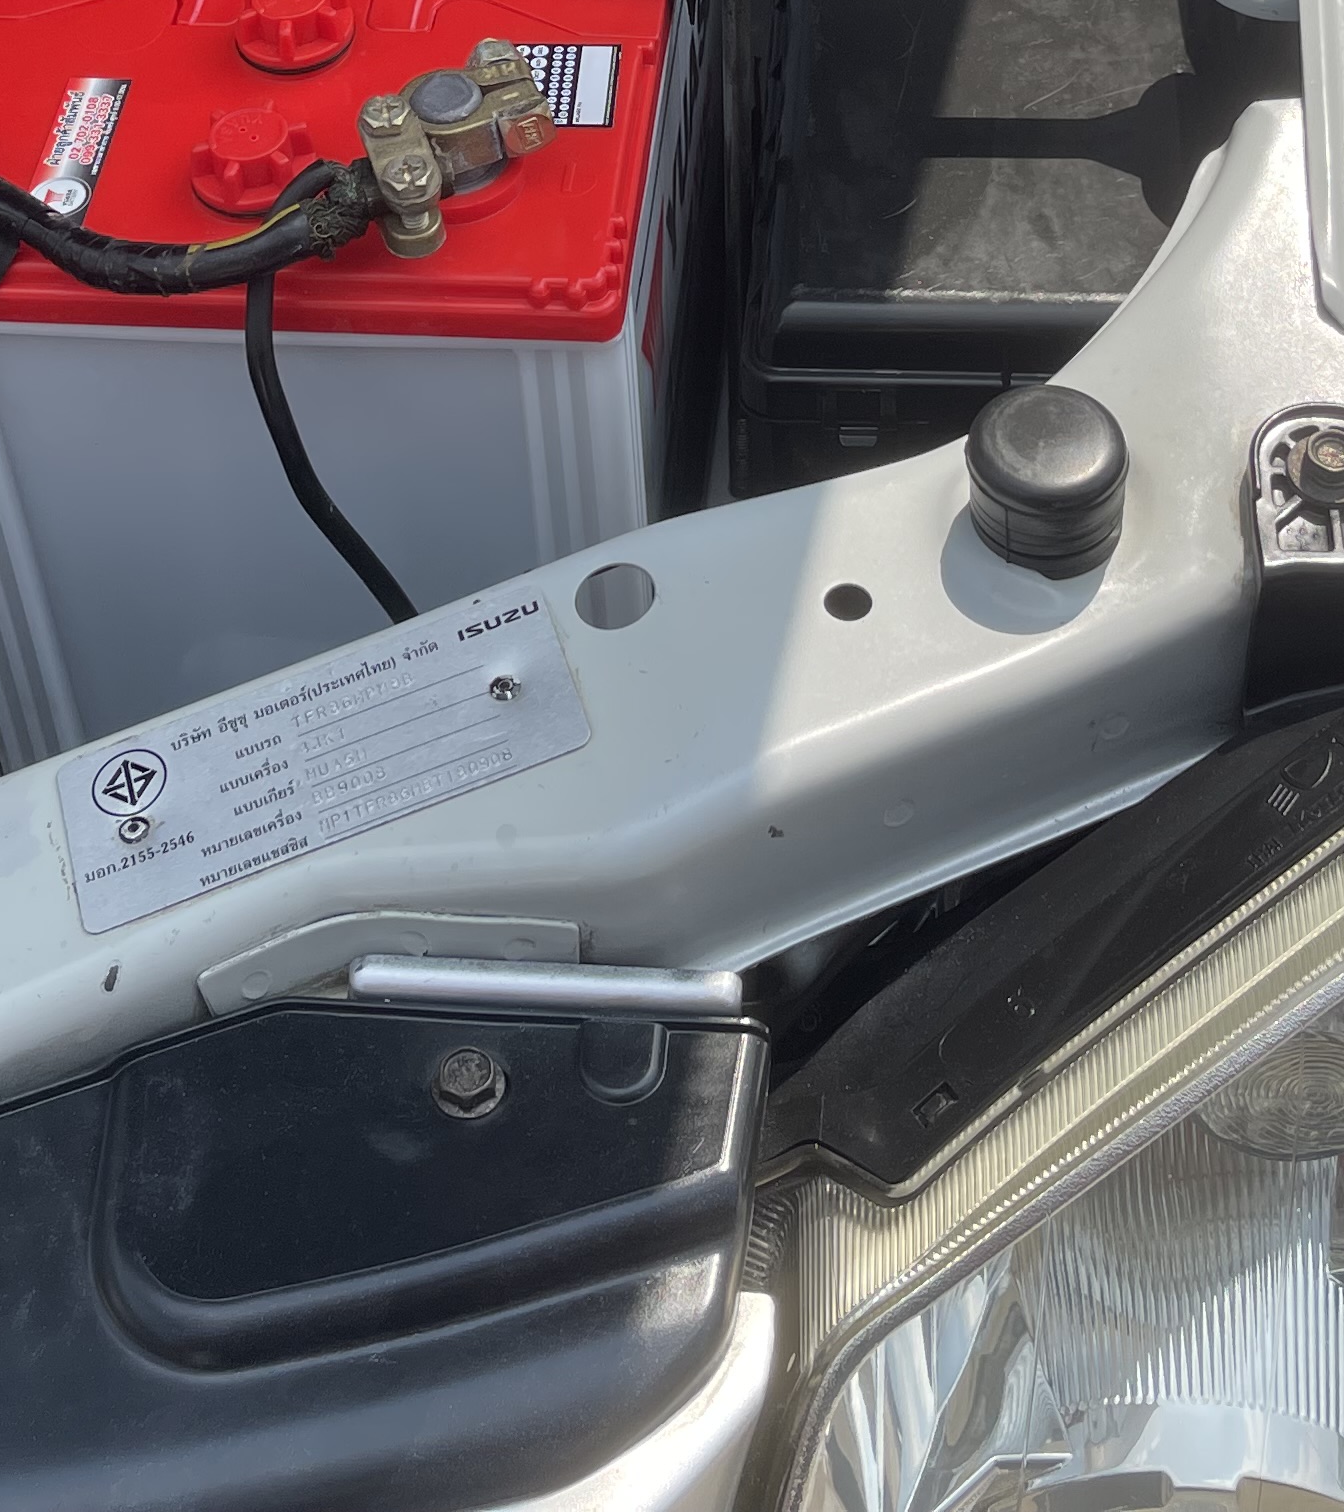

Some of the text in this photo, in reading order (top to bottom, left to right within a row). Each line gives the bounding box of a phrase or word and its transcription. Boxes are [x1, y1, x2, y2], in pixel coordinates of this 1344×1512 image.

[456, 599, 540, 643] ISUZU
[170, 724, 212, 754] บริษัท
[253, 657, 398, 720] มอเตอร์(ประเทศไทย)
[401, 638, 439, 665] จำกัด
[235, 733, 283, 760] แบบรถ
[219, 757, 290, 794] แบบเครื่อง
[233, 781, 297, 818] แบบเกียร์
[201, 808, 303, 859] หมายเลขเครื่อง
[84, 830, 196, 885] มอก.2155-2546
